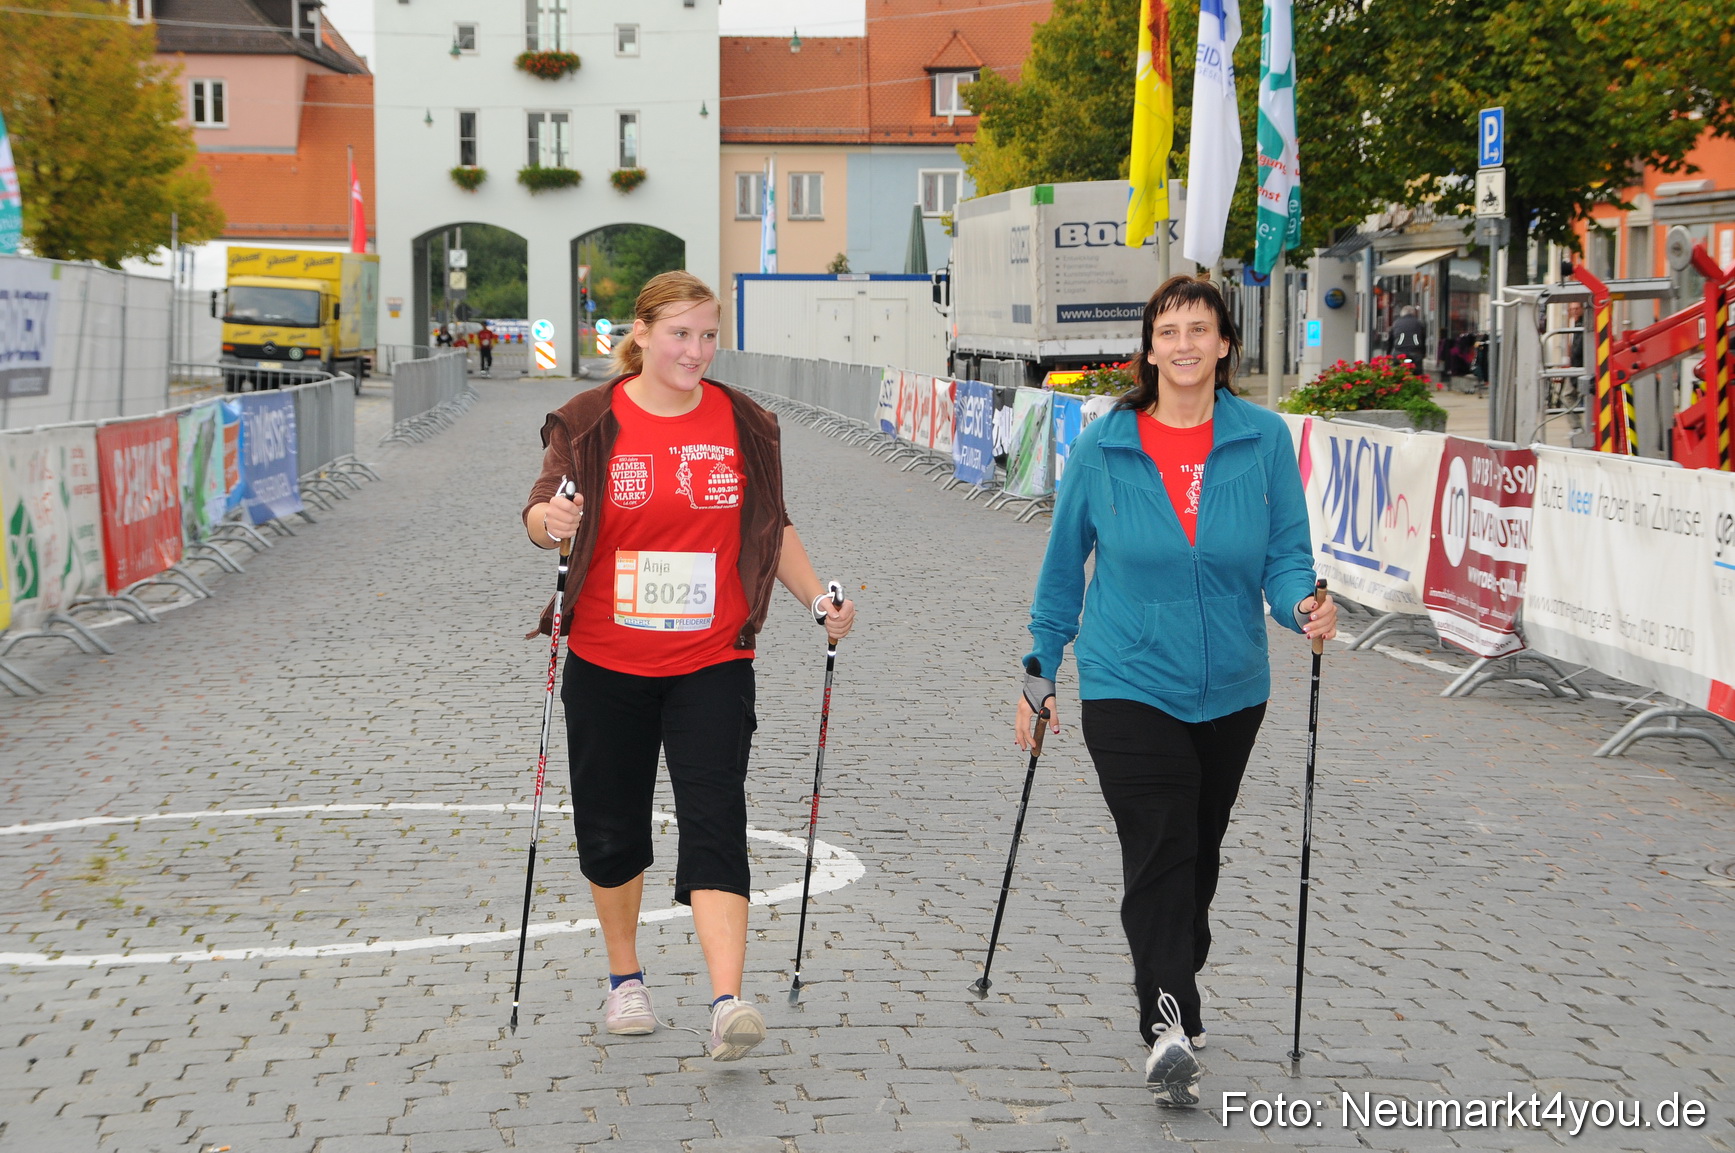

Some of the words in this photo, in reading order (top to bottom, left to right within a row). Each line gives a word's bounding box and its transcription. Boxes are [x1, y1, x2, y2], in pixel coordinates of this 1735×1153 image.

[1484, 116, 1499, 160] P
[668, 446, 681, 455] 11.
[682, 444, 734, 456] NEUMARKTER
[681, 452, 725, 461] STADTLAUF
[612, 462, 646, 471] IMMER
[611, 470, 648, 480] WIEDER
[613, 479, 646, 492] NEU
[614, 492, 647, 501] MARKT
[643, 558, 670, 576] Anja
[644, 582, 707, 605] 8025
[676, 618, 711, 626] PFLEIDERER
[546, 655, 558, 695] WAY
